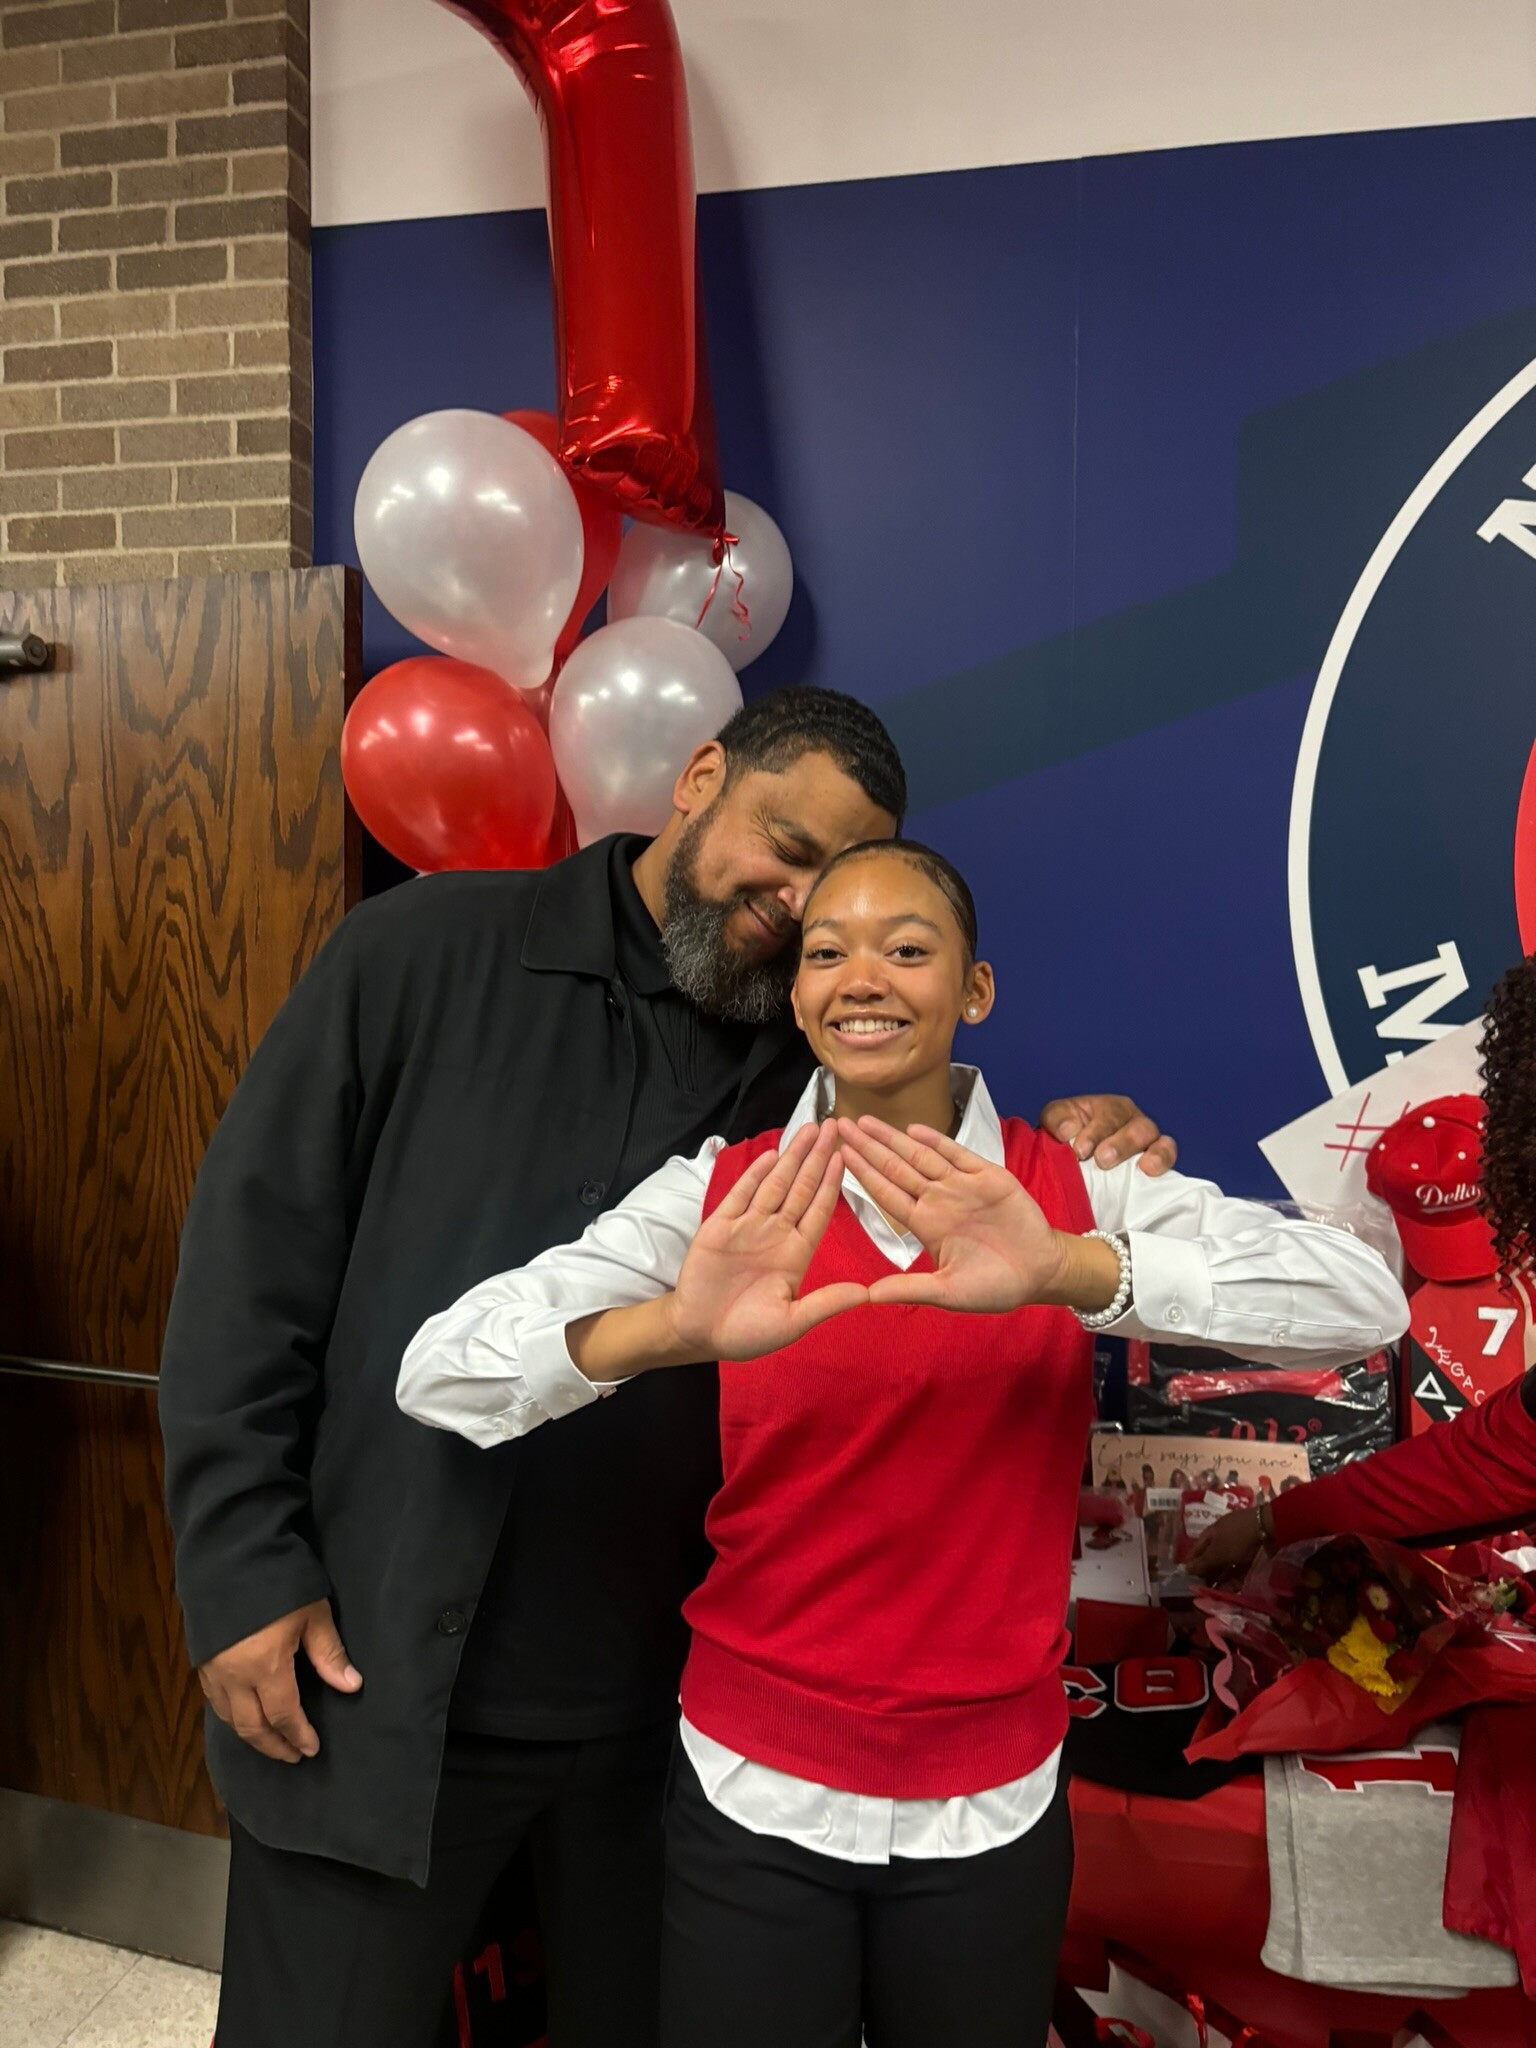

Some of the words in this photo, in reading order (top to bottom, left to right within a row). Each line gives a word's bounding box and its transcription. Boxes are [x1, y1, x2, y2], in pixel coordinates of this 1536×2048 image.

[1477, 1306, 1519, 1356] 7
[1098, 1436, 1150, 1467] God
[1160, 1450, 1204, 1469] says
[1212, 1454, 1252, 1472] you
[1259, 1457, 1293, 1468] are
